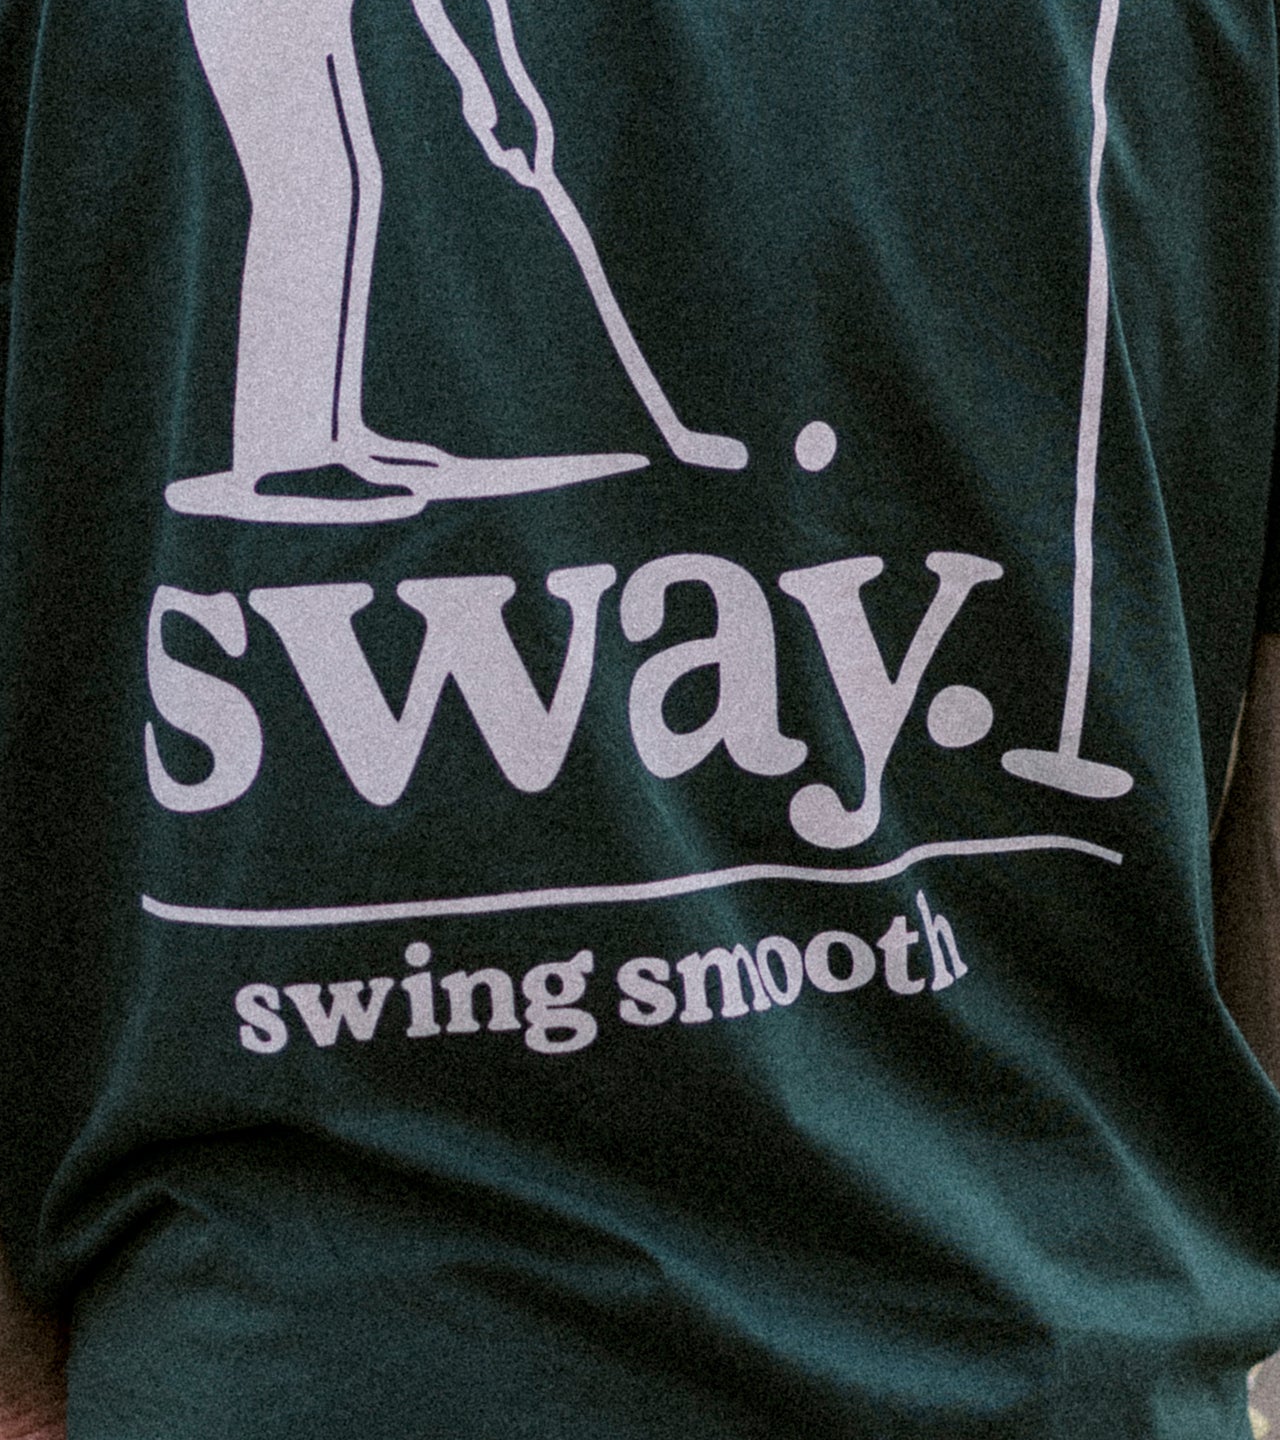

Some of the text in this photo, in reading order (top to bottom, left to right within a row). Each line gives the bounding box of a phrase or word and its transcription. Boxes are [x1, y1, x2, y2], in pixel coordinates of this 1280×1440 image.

[144, 551, 1004, 849] sway.
[235, 889, 968, 1054] swing smooth
